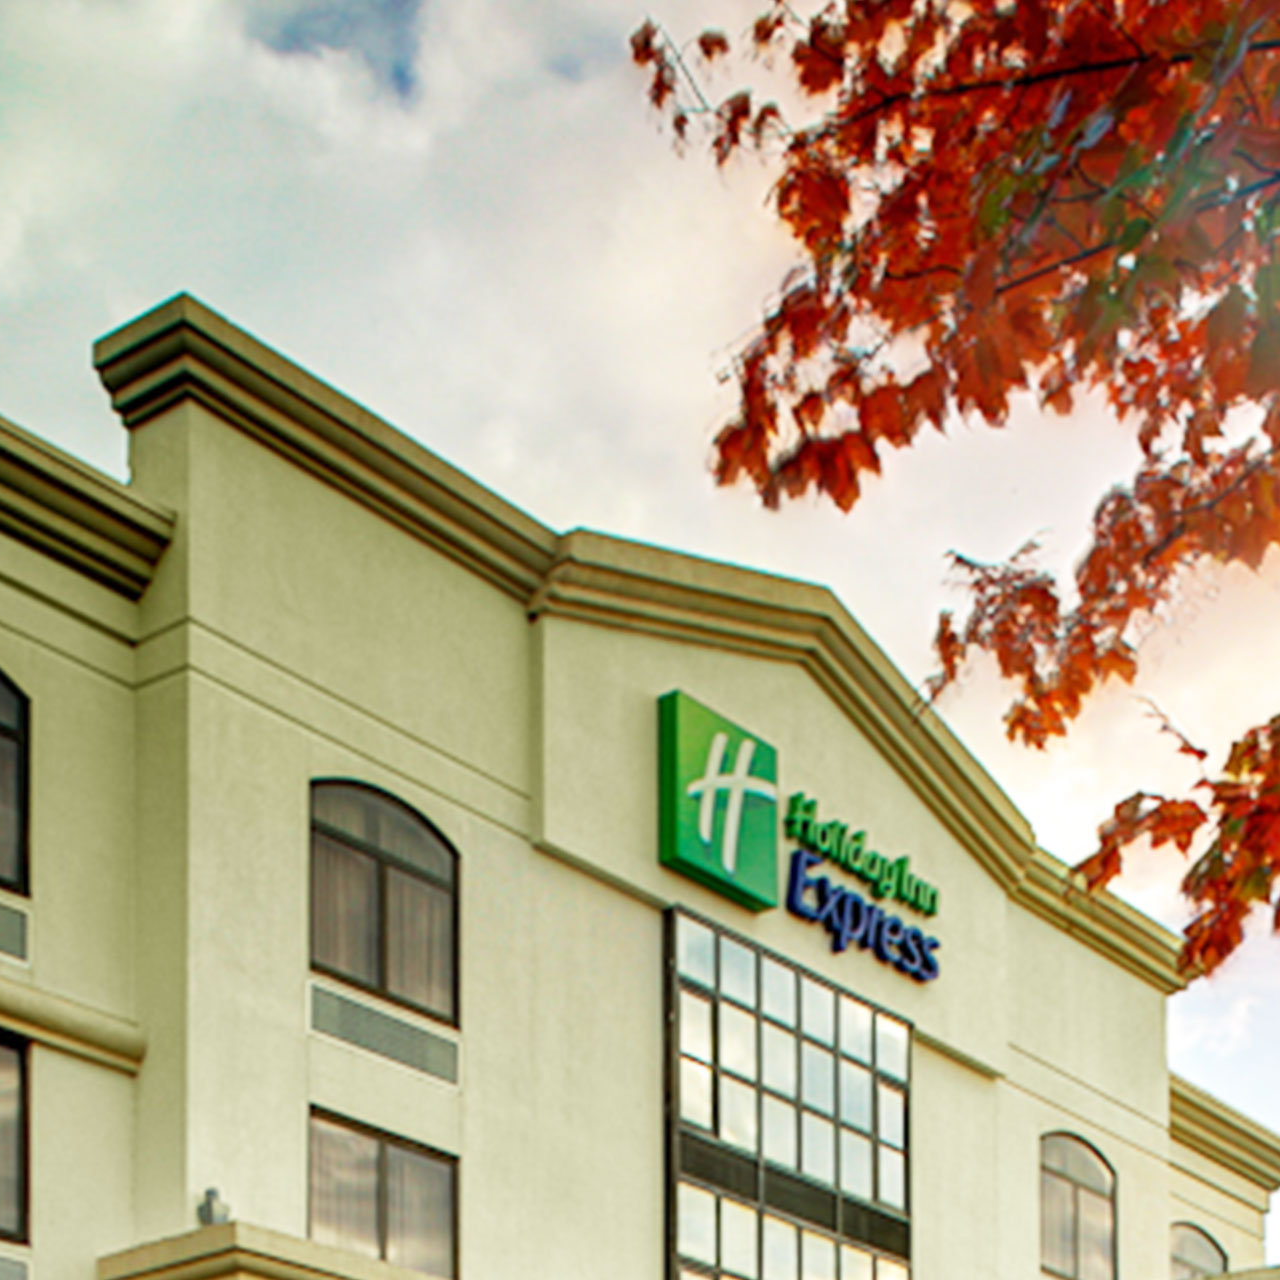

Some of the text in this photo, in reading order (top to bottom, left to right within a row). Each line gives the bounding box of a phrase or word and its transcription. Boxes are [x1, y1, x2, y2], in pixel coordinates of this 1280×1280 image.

[784, 791, 938, 916] Holiday Inn
[786, 849, 940, 982] Express
